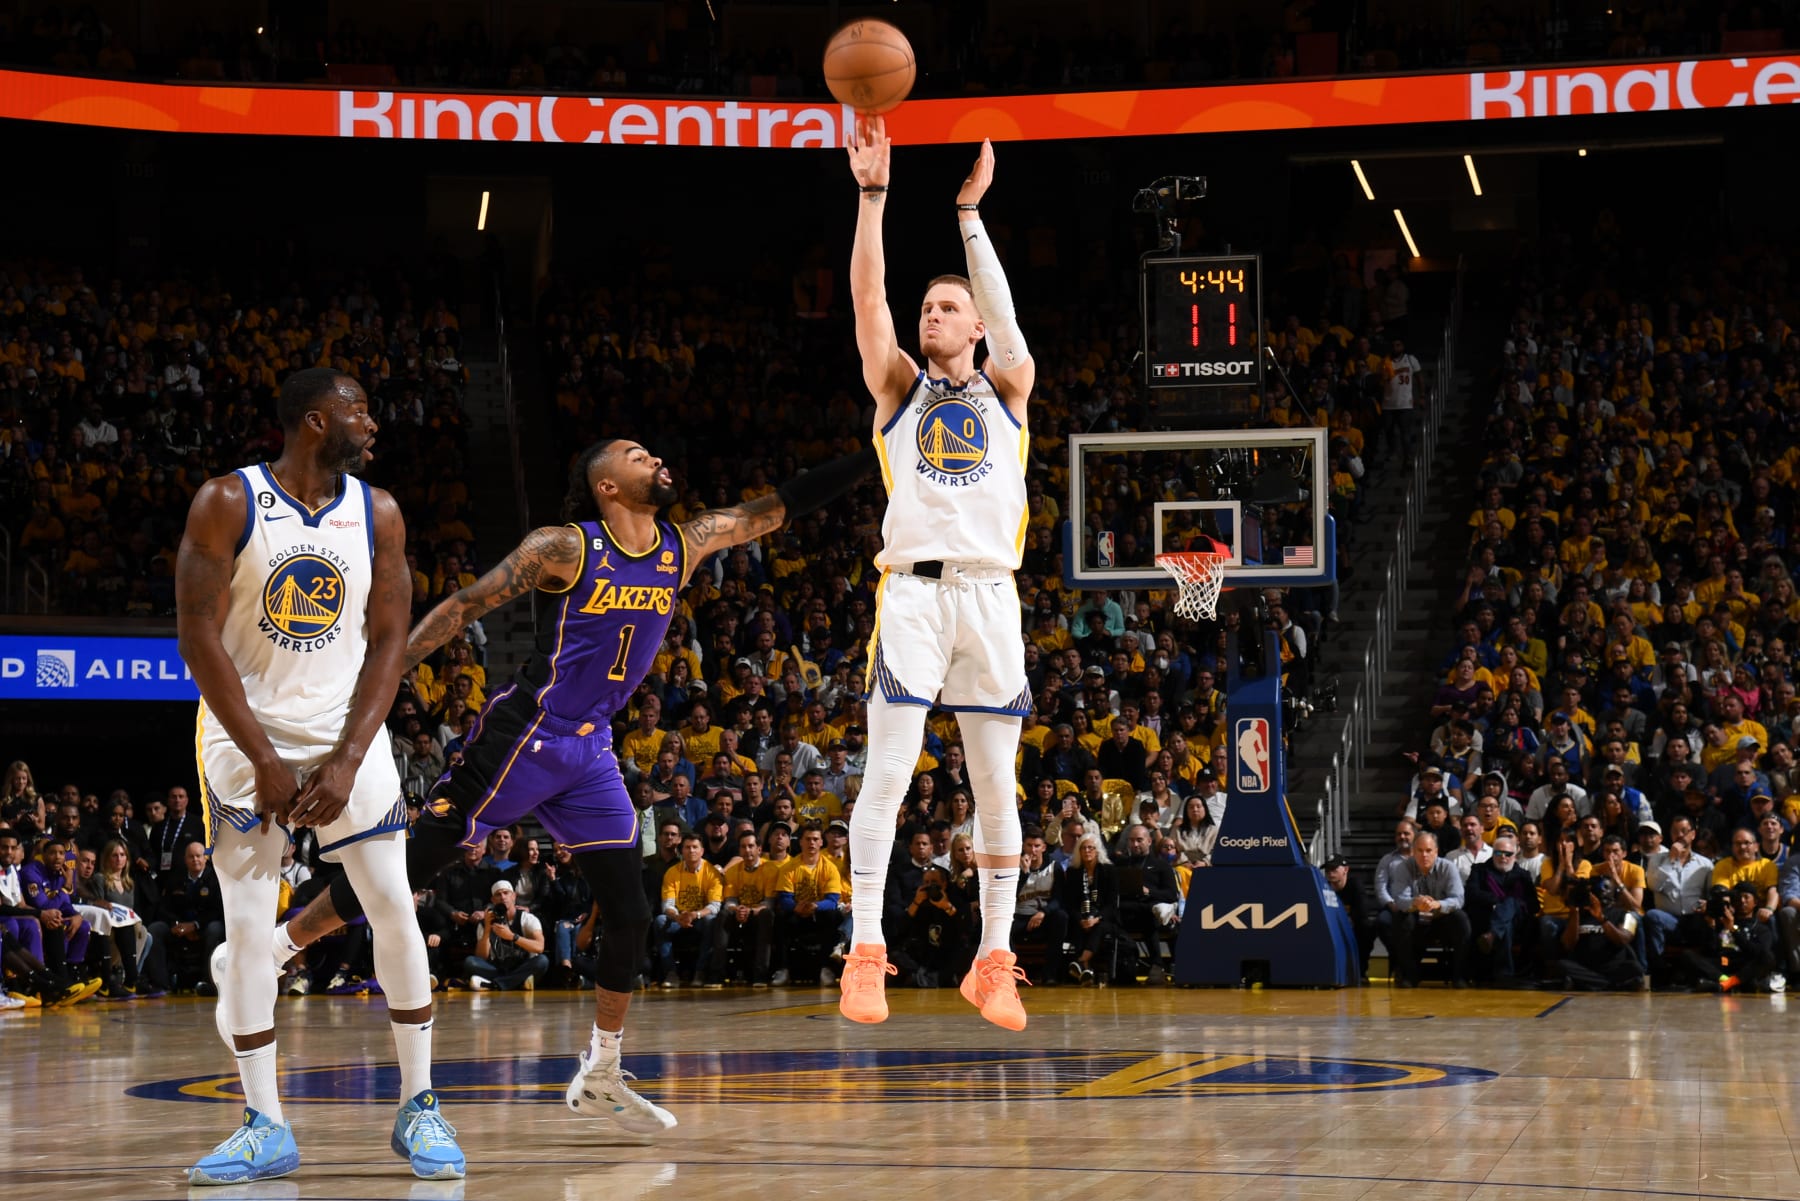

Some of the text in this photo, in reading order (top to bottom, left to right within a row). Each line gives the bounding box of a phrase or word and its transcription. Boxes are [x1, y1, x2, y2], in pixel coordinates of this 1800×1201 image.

[339, 91, 856, 148] RingCentral
[1180, 269, 1244, 294] 4:44
[1191, 303, 1236, 347] 11
[1180, 361, 1254, 376] TISSOT
[961, 392, 989, 415] STATE
[963, 418, 975, 438] 0
[916, 459, 993, 487] WARRIORS
[260, 493, 272, 507] 6
[329, 519, 360, 528] Rakuten
[593, 538, 603, 550] 6
[268, 544, 350, 574] GOLDEN STATE
[656, 564, 678, 574] bibigo
[309, 576, 339, 600] 23
[579, 578, 674, 615] LAKERS
[257, 616, 342, 653] WARRIORS
[607, 624, 636, 681] 1
[1241, 775, 1258, 788] NBA
[1219, 836, 1288, 849] Google Pixel
[1201, 903, 1309, 929] KIA
